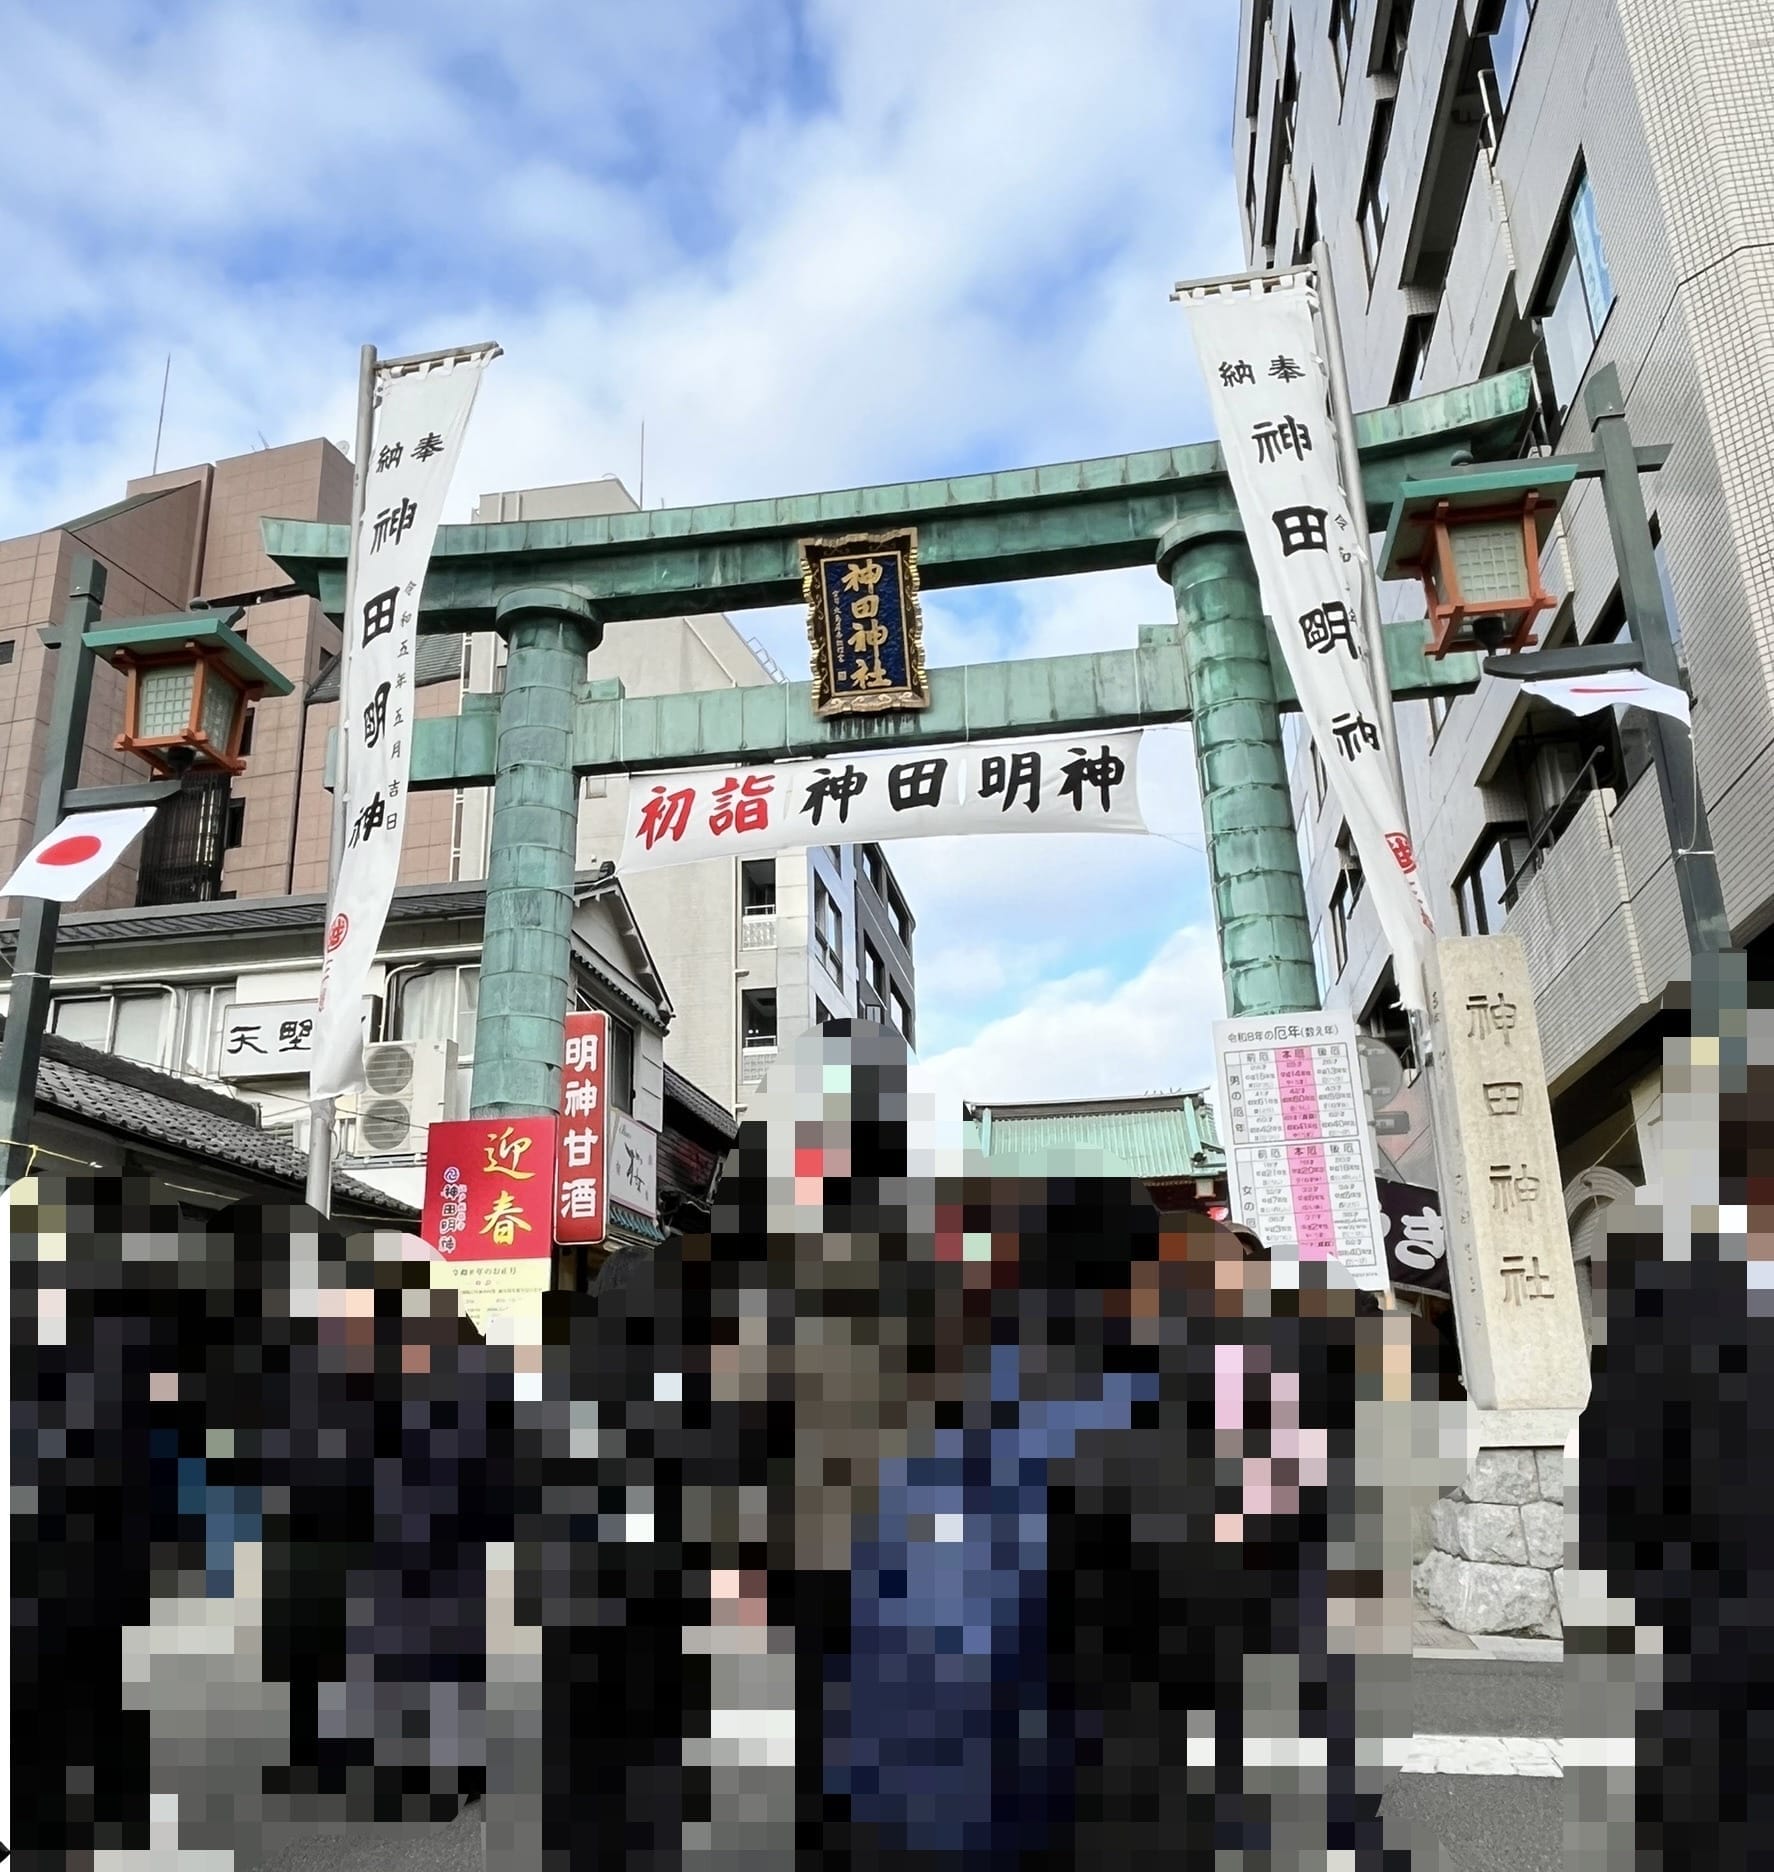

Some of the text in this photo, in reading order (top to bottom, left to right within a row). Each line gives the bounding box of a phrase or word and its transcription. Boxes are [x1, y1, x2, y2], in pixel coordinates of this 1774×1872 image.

[347, 497, 418, 849] 神田明神
[841, 559, 893, 690] 神田神社
[1251, 414, 1382, 763] 神田明神
[479, 1126, 537, 1246] 迎春
[560, 1034, 599, 1219] 明神甘酒
[1465, 992, 1556, 1307] 神田神社
